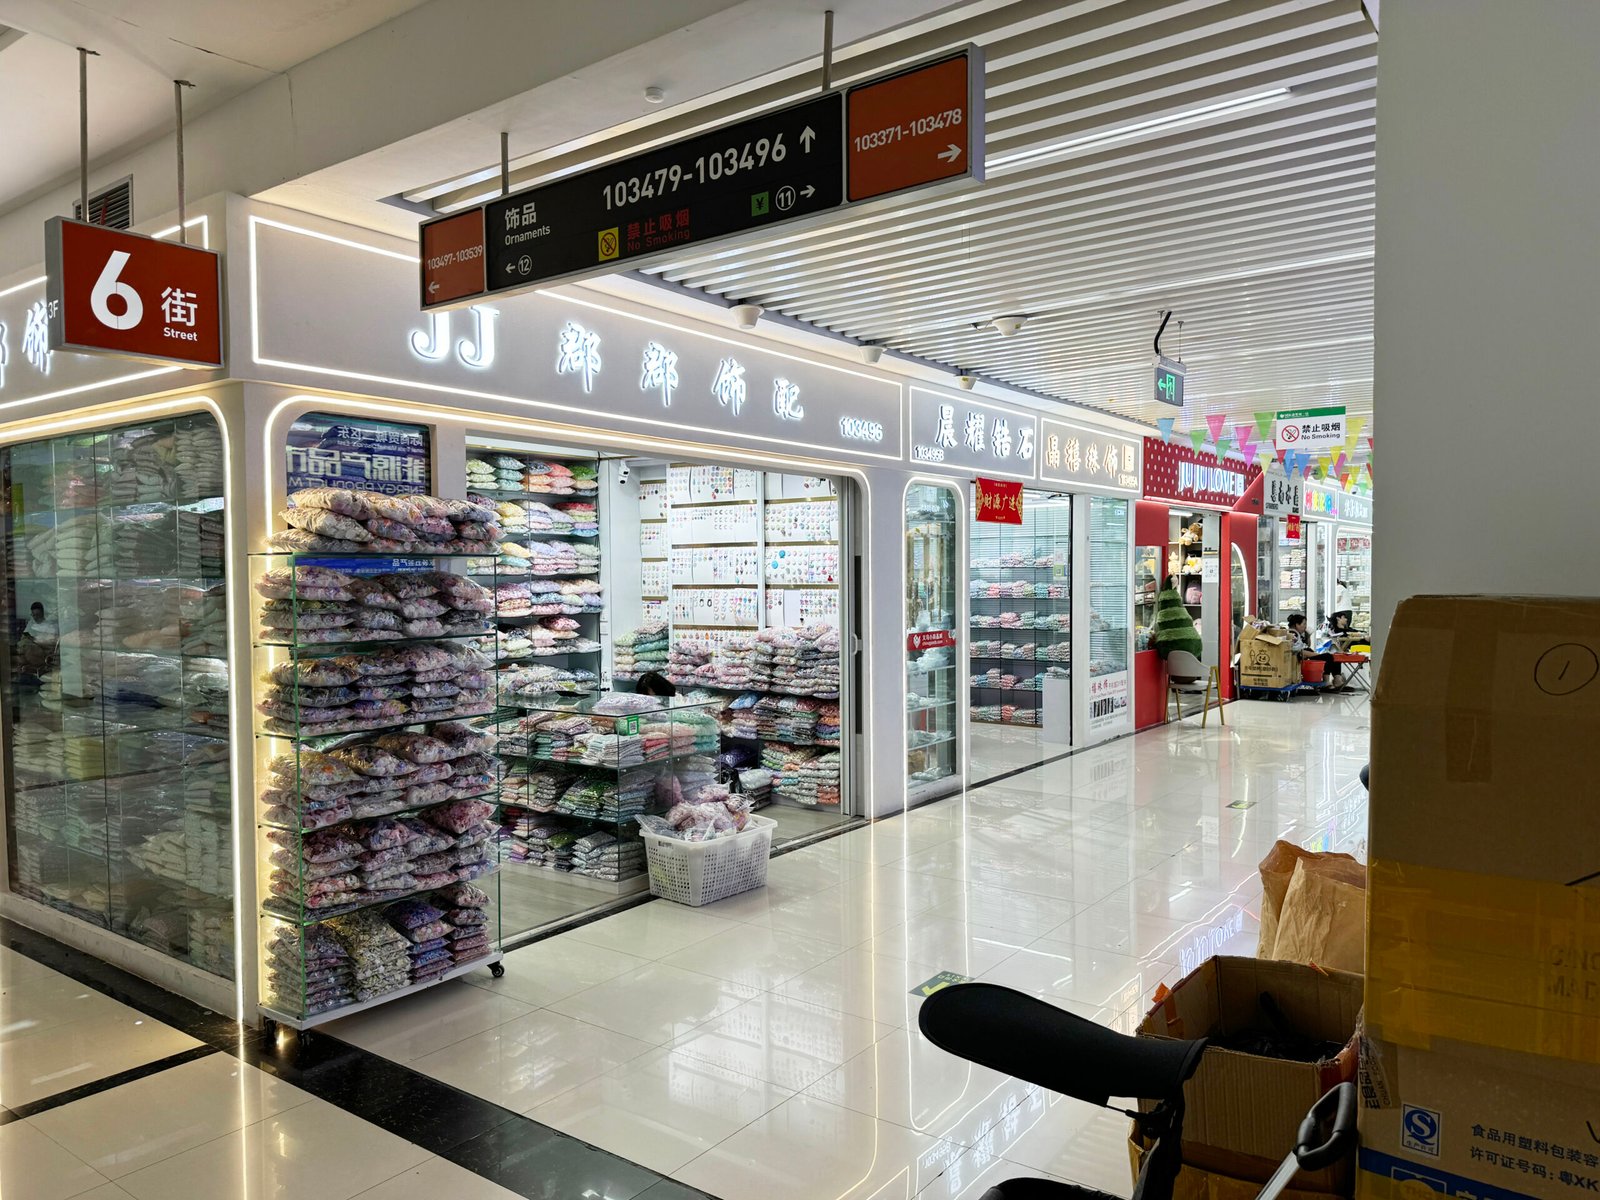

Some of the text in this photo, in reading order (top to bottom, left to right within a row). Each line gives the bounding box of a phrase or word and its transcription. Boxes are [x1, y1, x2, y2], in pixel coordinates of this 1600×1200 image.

[854, 108, 962, 152] 103371-103478
[603, 133, 787, 210] 103479-103496
[505, 202, 537, 231] 饰品
[627, 208, 690, 241] 禁止吸烟
[505, 225, 551, 246] Ornaments
[627, 228, 690, 252] No Smoking
[427, 245, 483, 270] 103497-103539
[519, 256, 531, 274] 12
[90, 250, 198, 330] 6 街
[48, 300, 59, 319] 3F
[163, 326, 198, 342] Street
[839, 416, 883, 441] 103496
[1302, 422, 1341, 434] 禁止吸烟
[1312, 432, 1341, 440] Smoking
